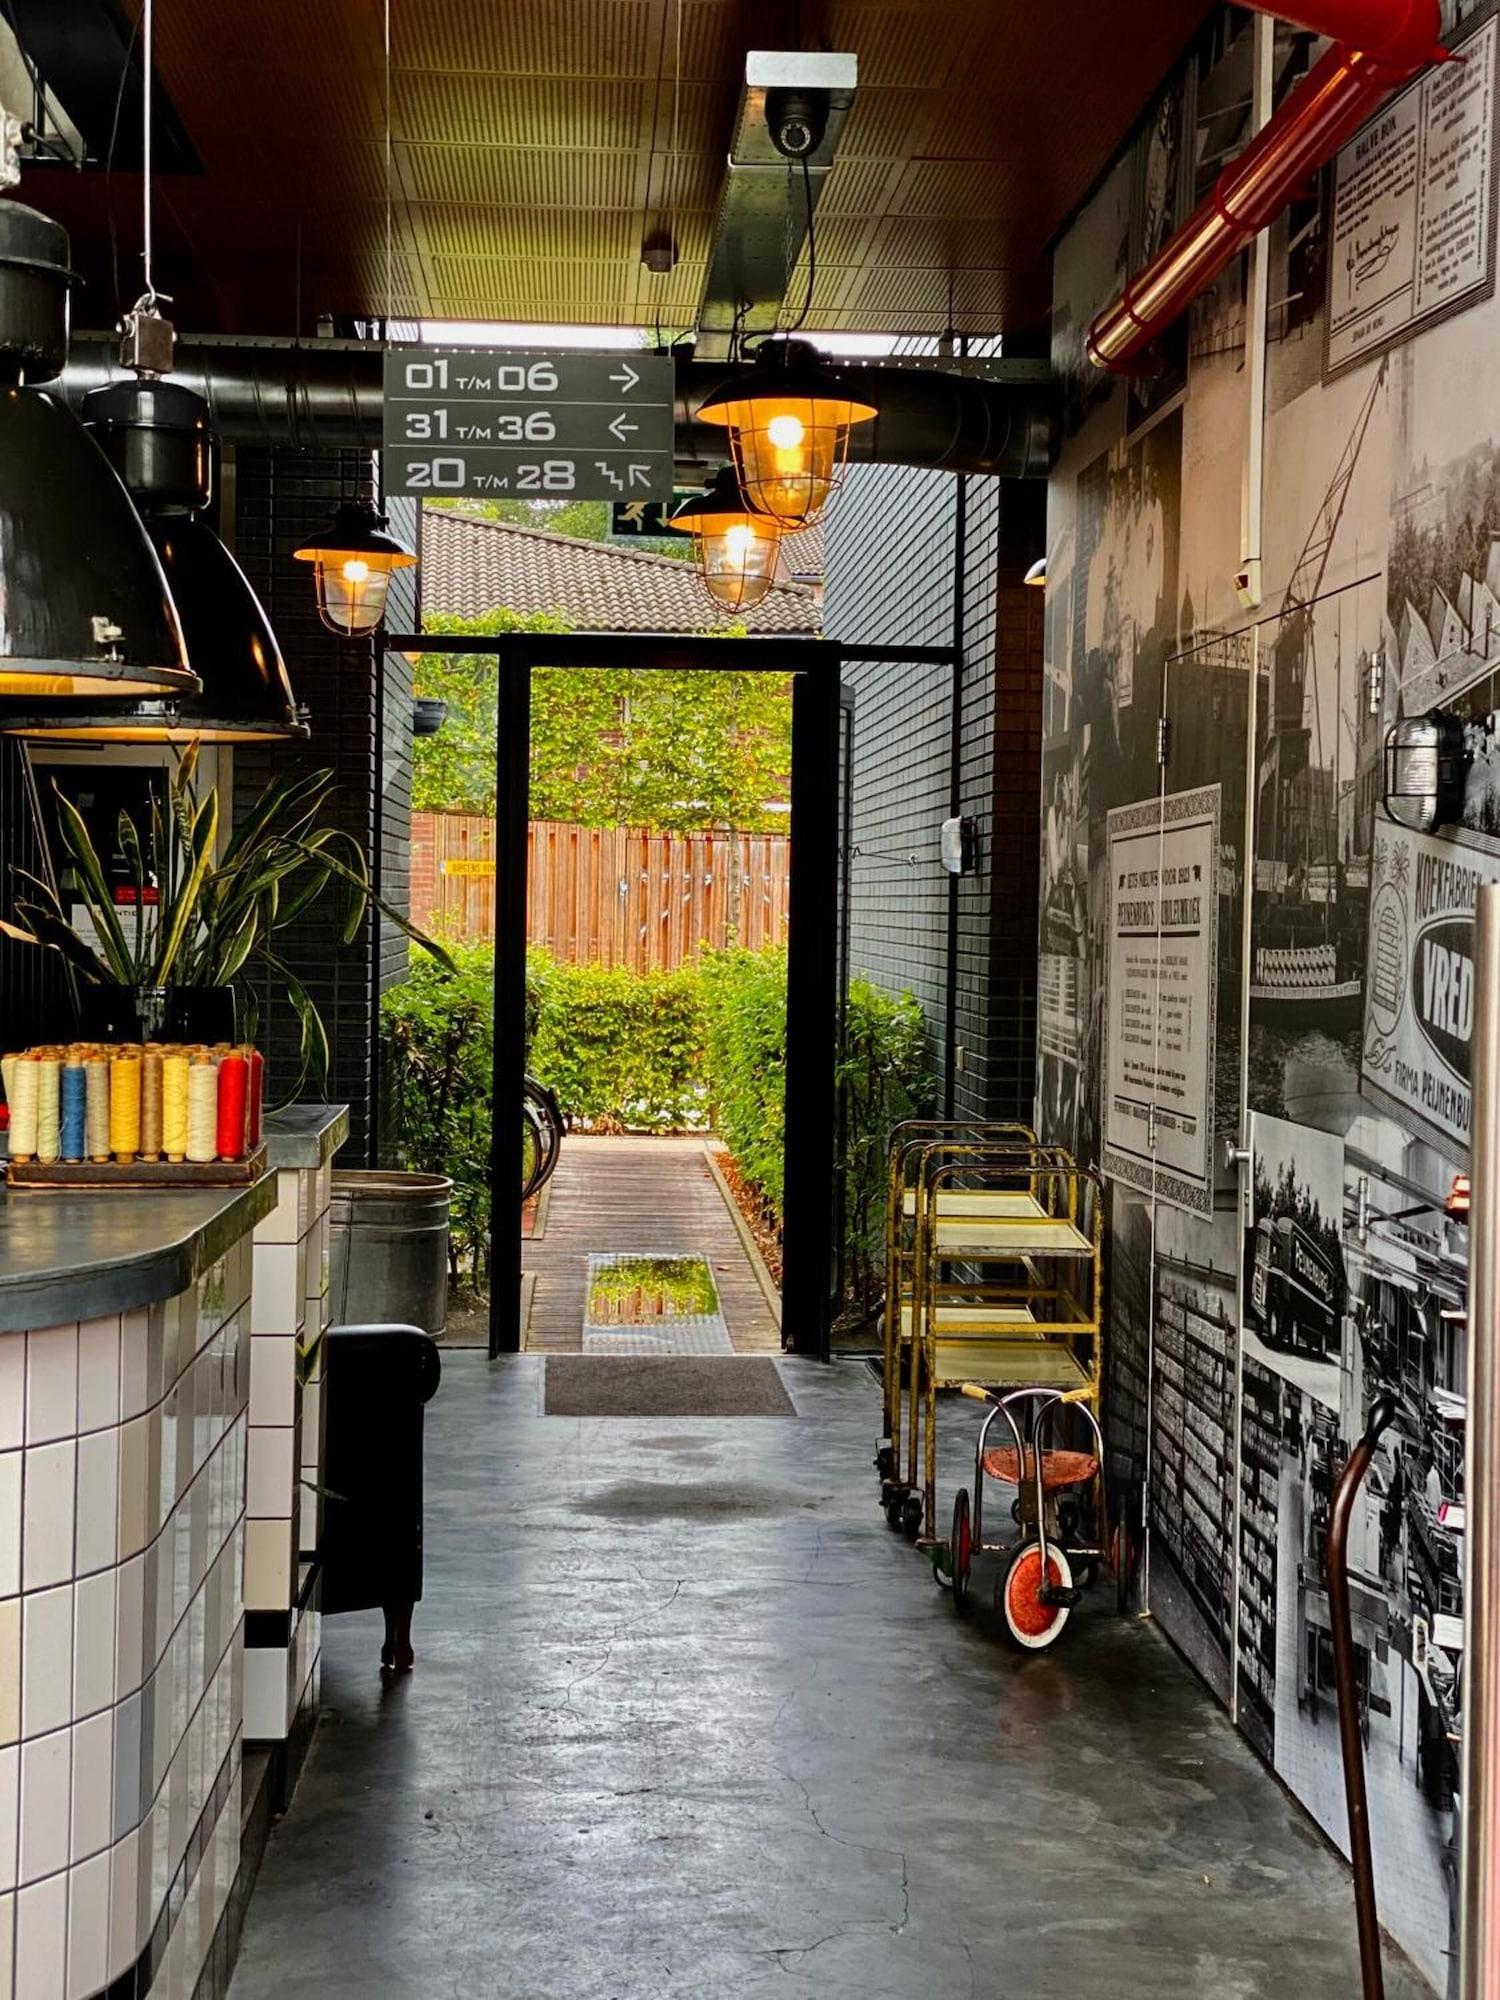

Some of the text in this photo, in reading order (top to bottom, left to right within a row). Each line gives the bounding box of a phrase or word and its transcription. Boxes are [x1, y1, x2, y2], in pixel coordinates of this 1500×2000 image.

[405, 359, 559, 391] 01 T/M 06
[405, 409, 556, 441] 31 T/M 36
[405, 458, 575, 490] 20 T/M 28
[1394, 1059, 1418, 1098] FIRMA
